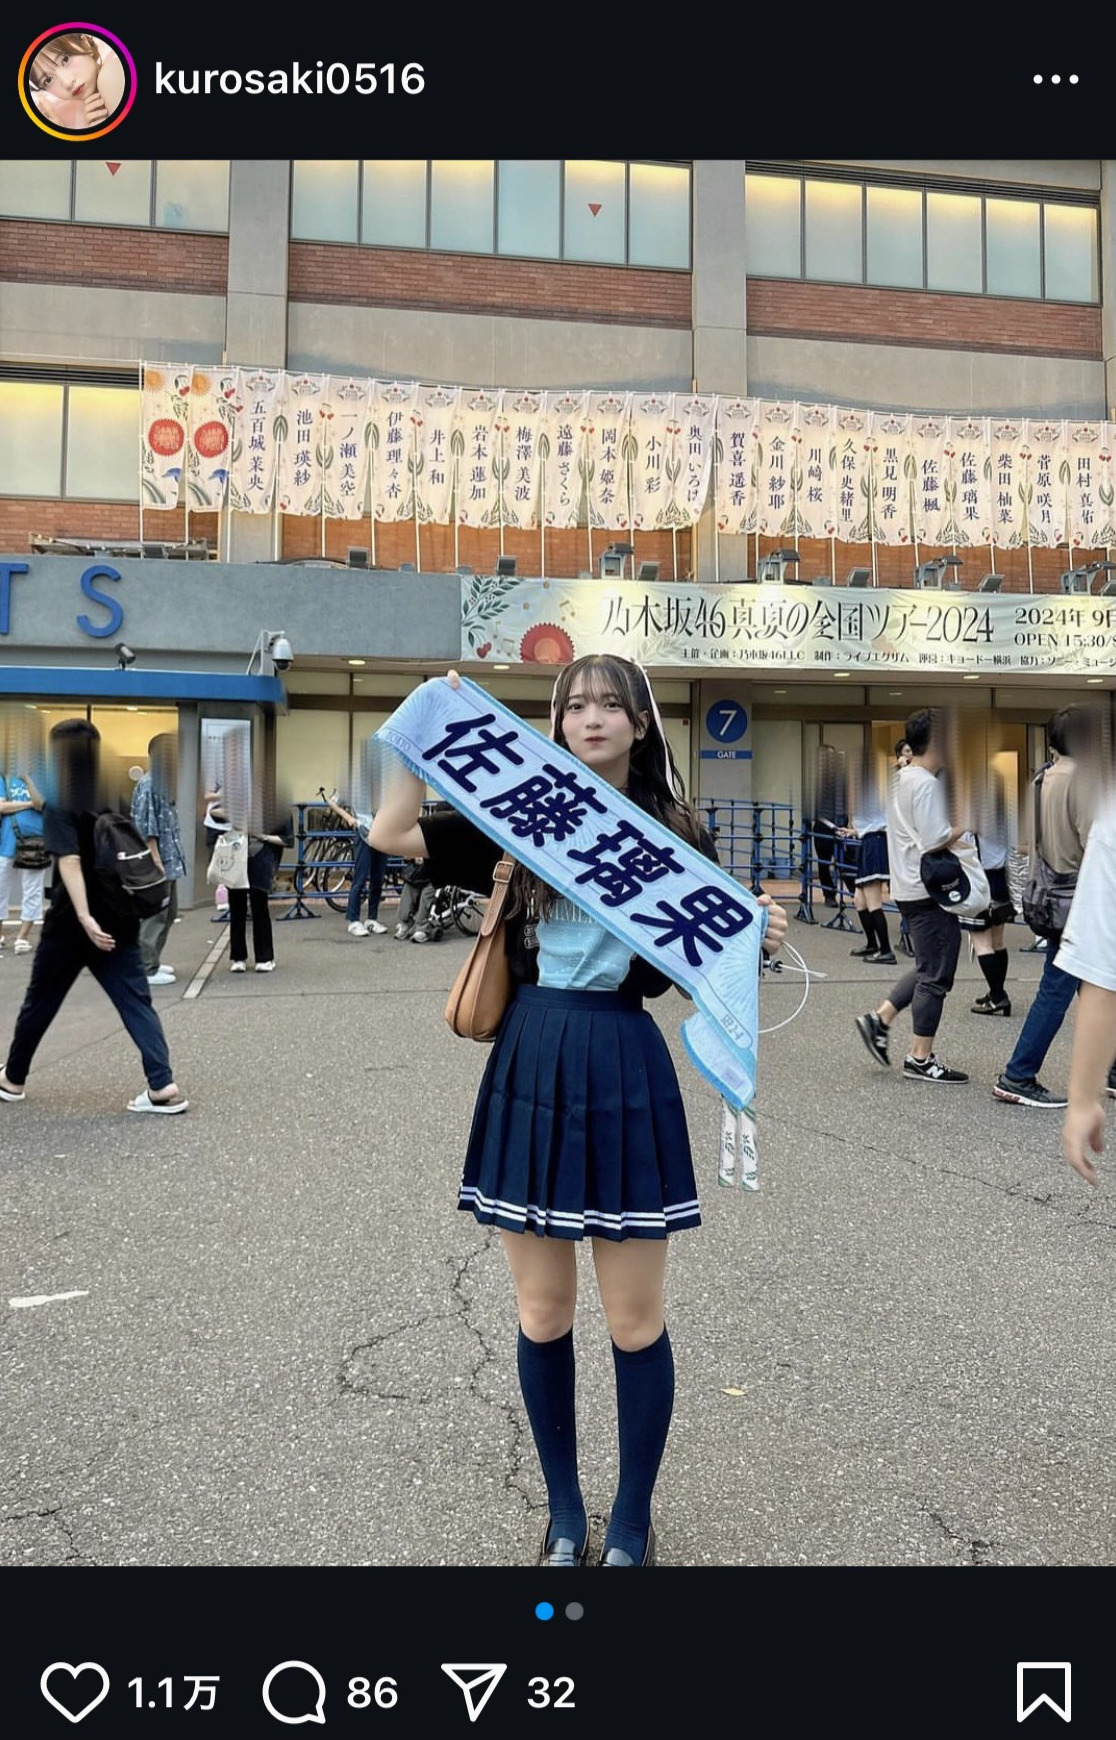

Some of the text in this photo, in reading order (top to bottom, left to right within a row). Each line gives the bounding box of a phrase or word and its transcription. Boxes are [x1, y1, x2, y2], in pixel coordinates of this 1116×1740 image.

[1014, 632, 1058, 647] OPEN
[719, 709, 737, 736] 7
[717, 751, 737, 759] GATE
[421, 713, 754, 968] 佐藤璃果
